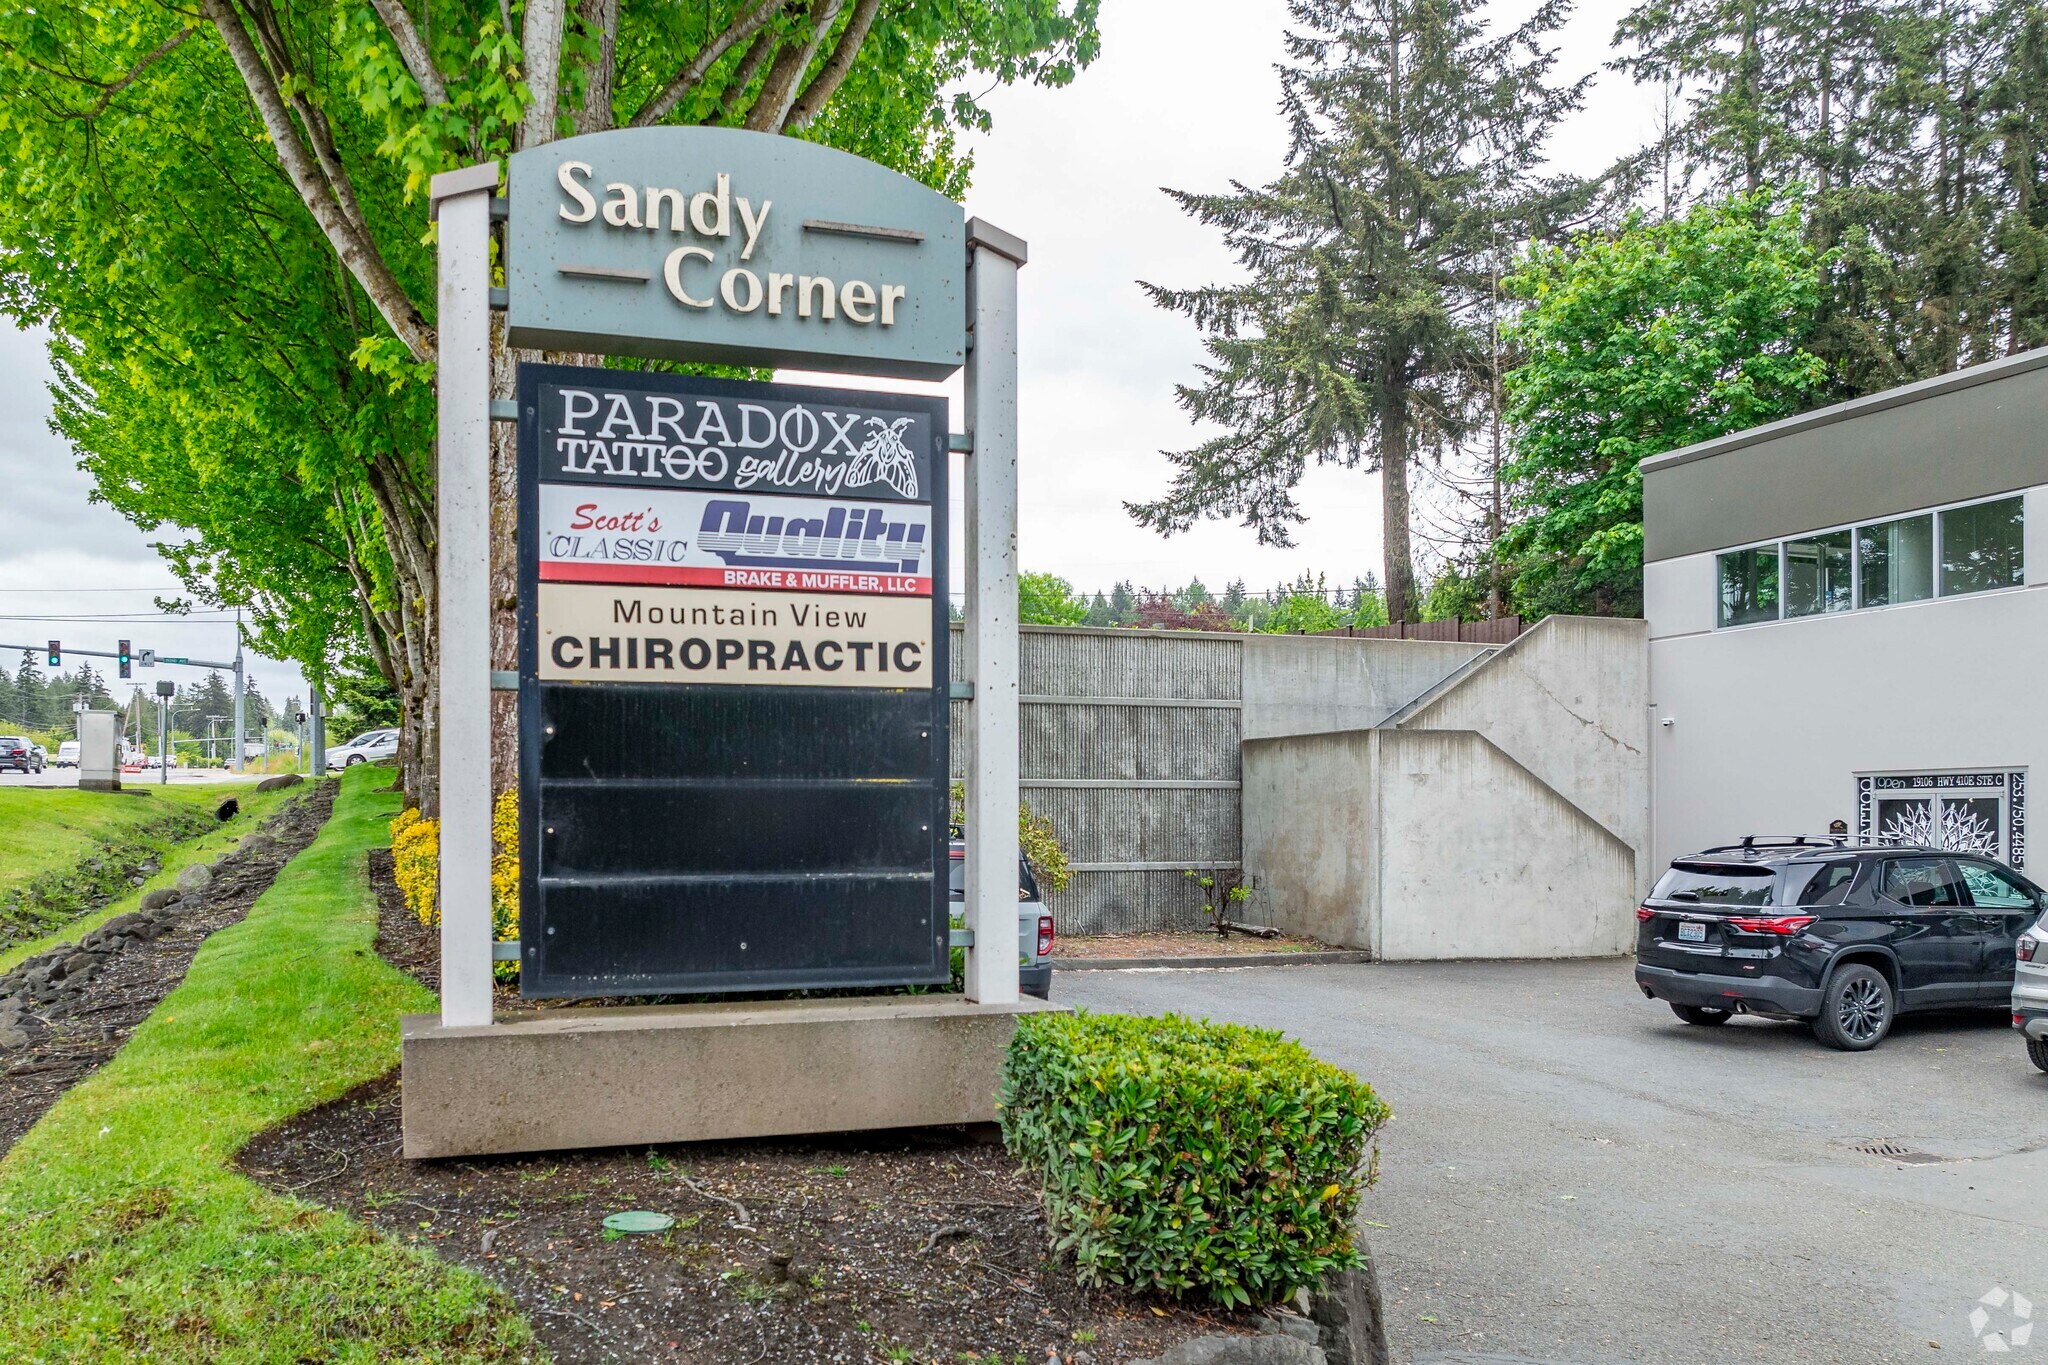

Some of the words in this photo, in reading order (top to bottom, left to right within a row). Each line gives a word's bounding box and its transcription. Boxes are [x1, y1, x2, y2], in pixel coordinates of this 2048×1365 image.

[557, 160, 772, 260] Sandy
[663, 245, 905, 325] Corner
[558, 389, 861, 456] PARADOX
[557, 438, 728, 481] TATTOO
[734, 449, 847, 495] gallery
[570, 504, 662, 532] Scott's
[697, 500, 925, 574] Quality
[549, 535, 688, 562] CLASSIC
[724, 571, 782, 586] BRAKE
[785, 574, 797, 587] &
[802, 573, 883, 593] MUFFLER,
[887, 578, 917, 592] LLC
[614, 600, 778, 626] Mountain
[790, 603, 867, 628] View
[551, 635, 922, 673] CHIROPRACTIC
[1913, 777, 1933, 787] 19106
[1937, 776, 1955, 786] HWY
[1956, 775, 1974, 786] 410E
[1976, 775, 1993, 786] STE
[1995, 775, 2002, 785] C
[1860, 779, 1871, 847] TATTOO
[2012, 773, 2025, 864] 253.750.4485
